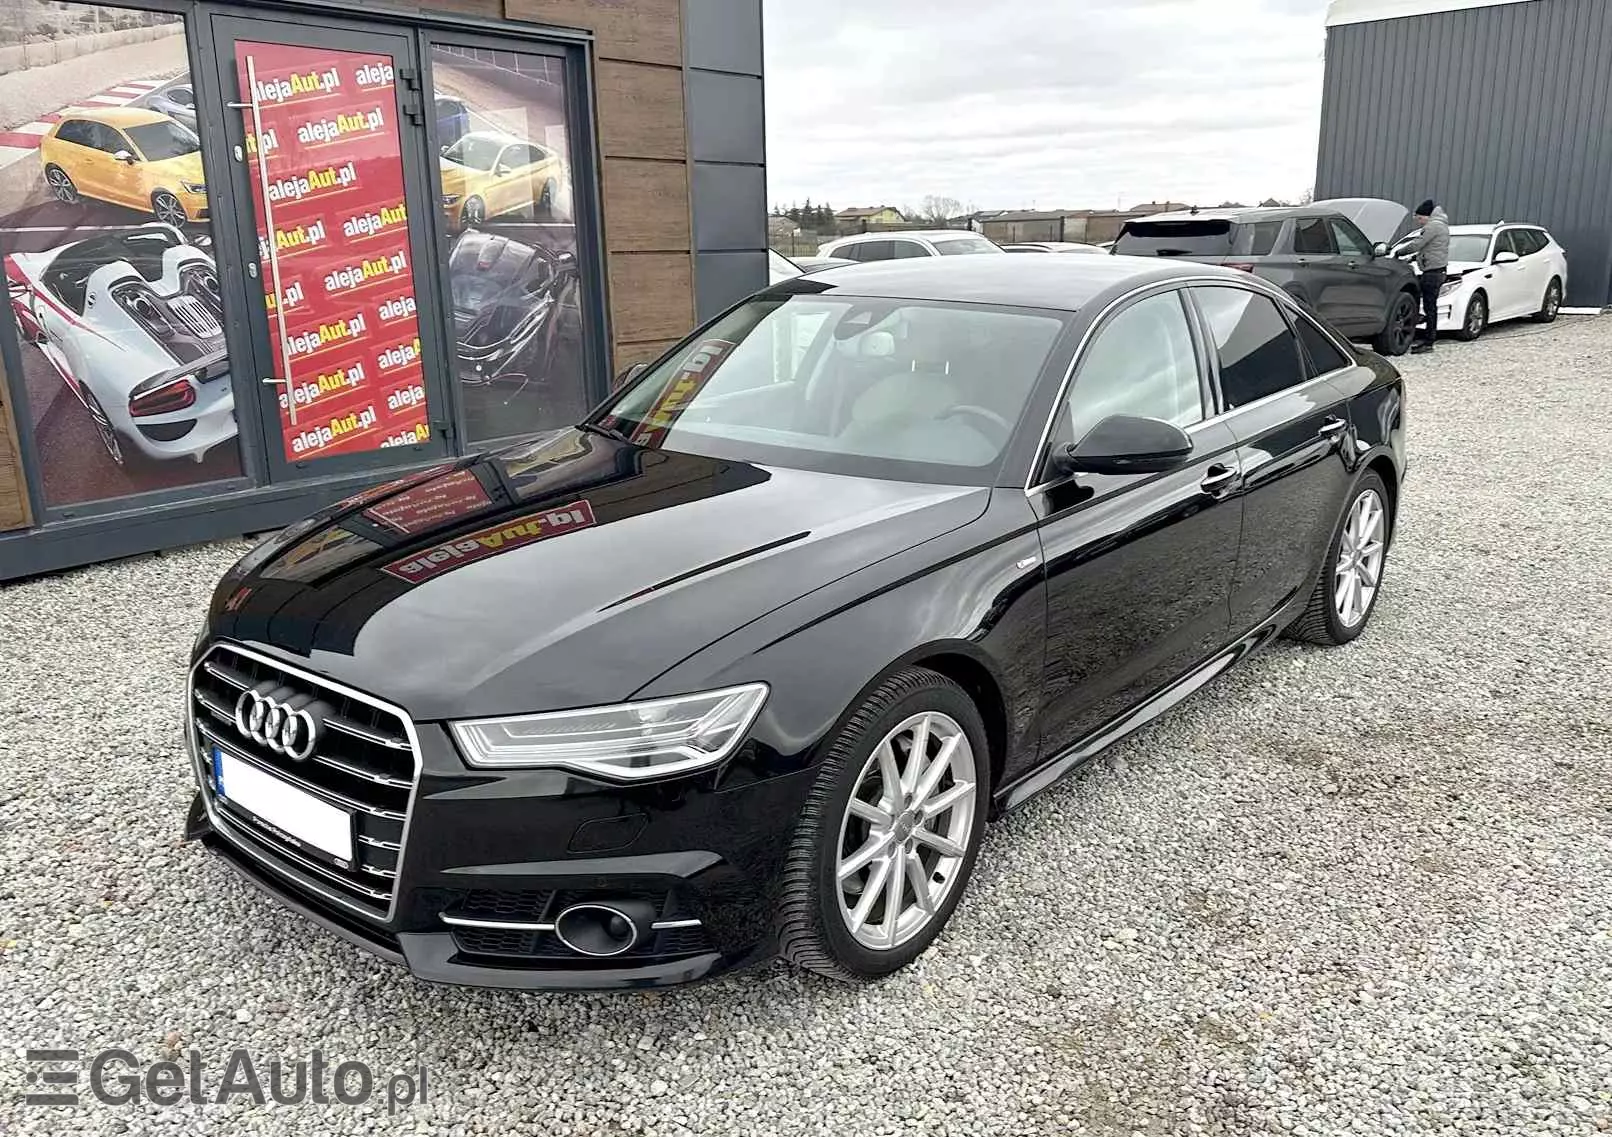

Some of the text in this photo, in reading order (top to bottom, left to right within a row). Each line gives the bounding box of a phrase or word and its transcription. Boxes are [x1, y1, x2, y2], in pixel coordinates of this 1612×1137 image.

[355, 62, 395, 85] aleja
[297, 107, 385, 143] alejaAut.pl
[268, 161, 357, 201] alejaAut.pl
[323, 250, 408, 292] alejaAut.pl
[378, 296, 417, 320] aleja
[278, 362, 366, 408] aejaAut.pl
[291, 405, 377, 452] alejaAut.pl
